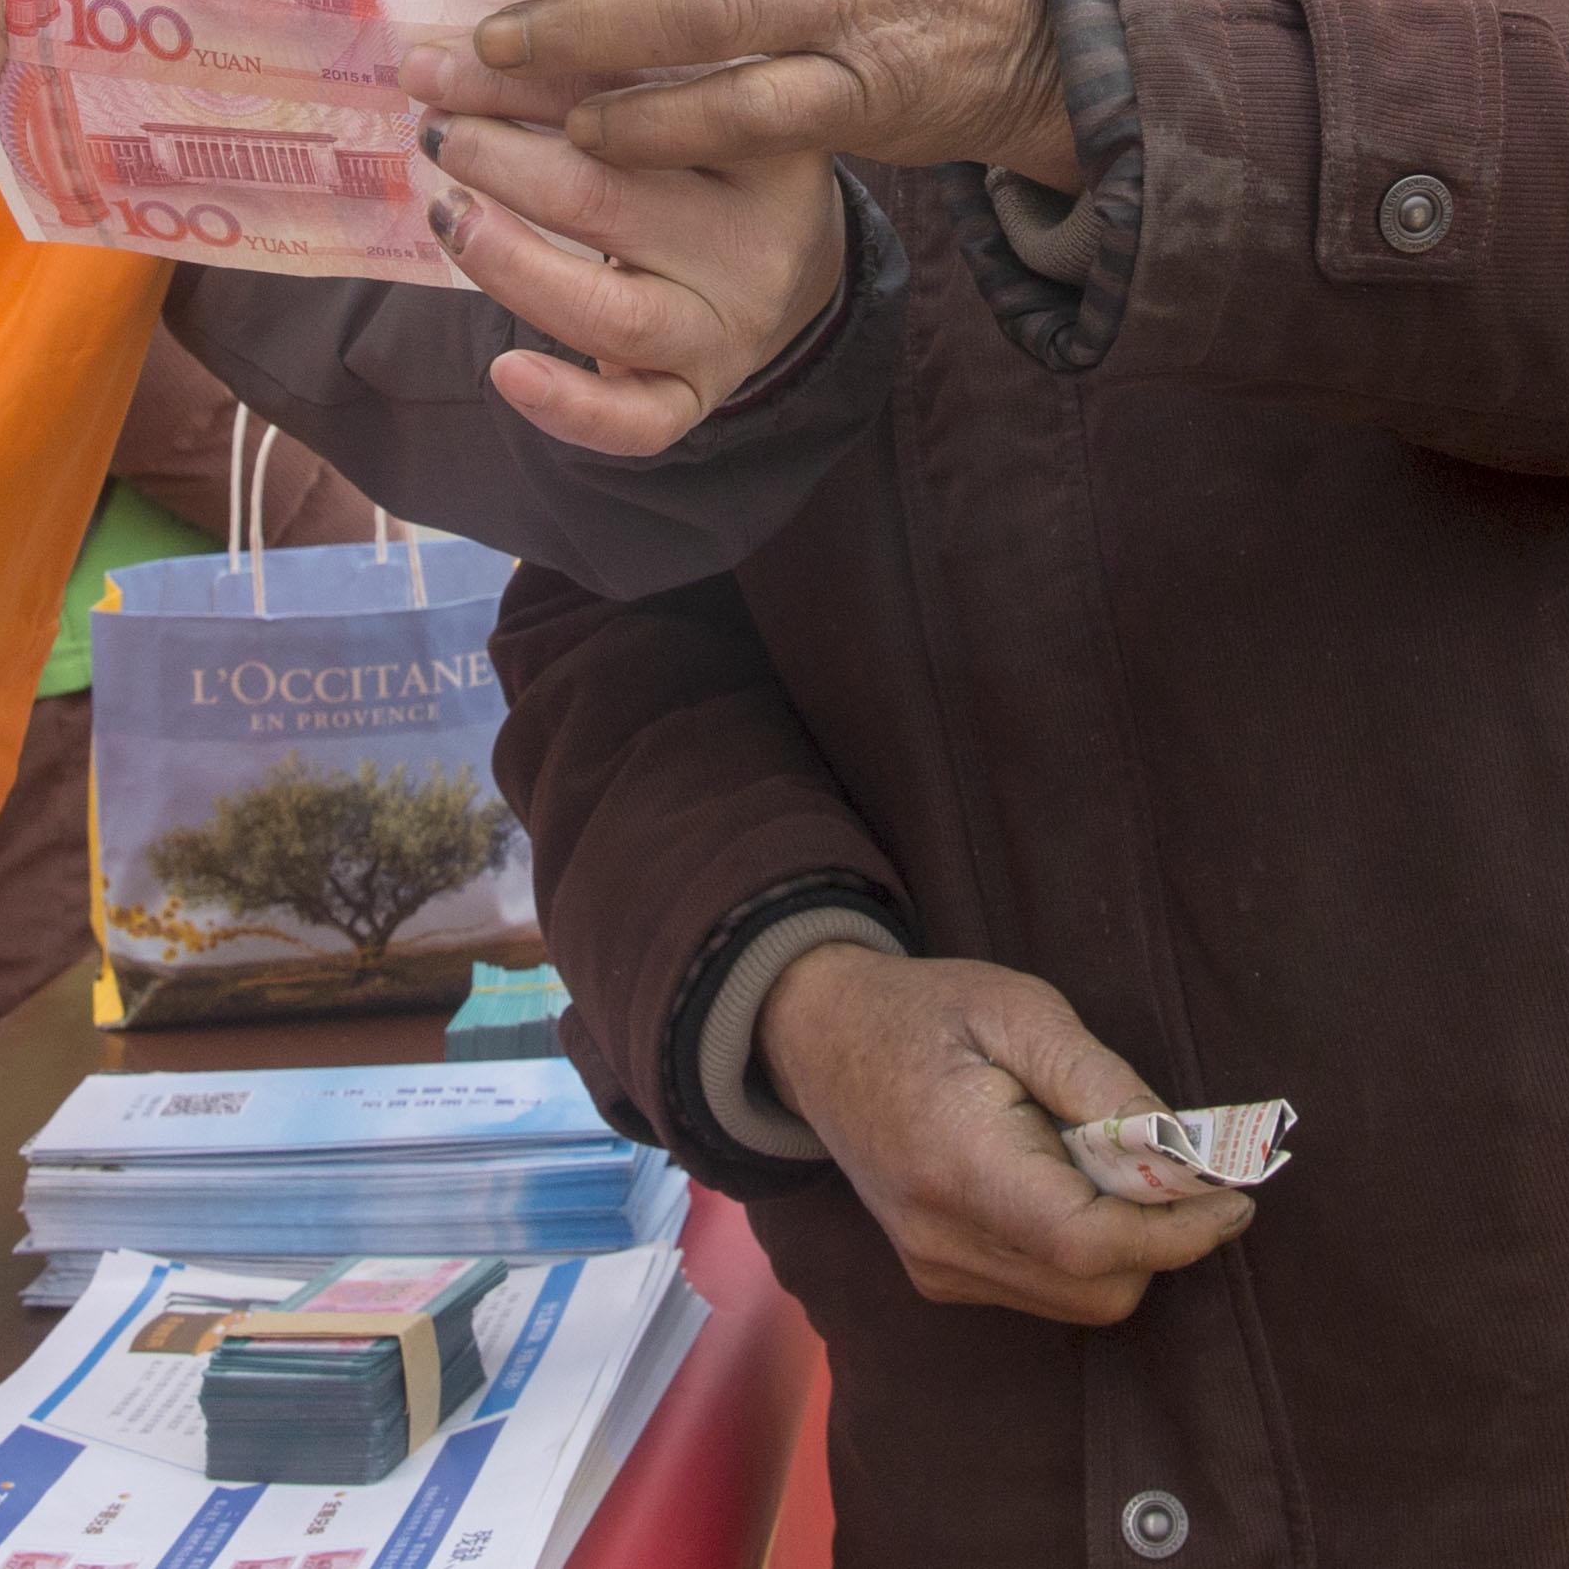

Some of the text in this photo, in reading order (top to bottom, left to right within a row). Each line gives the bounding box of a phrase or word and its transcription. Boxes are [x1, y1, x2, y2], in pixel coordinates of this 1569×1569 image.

[192, 47, 262, 75] YUAN
[320, 67, 373, 85] 2015年
[109, 198, 310, 256] 100 YUAN
[191, 649, 495, 707] L'OCCITANE
[250, 702, 441, 731] EN PROVENCE
